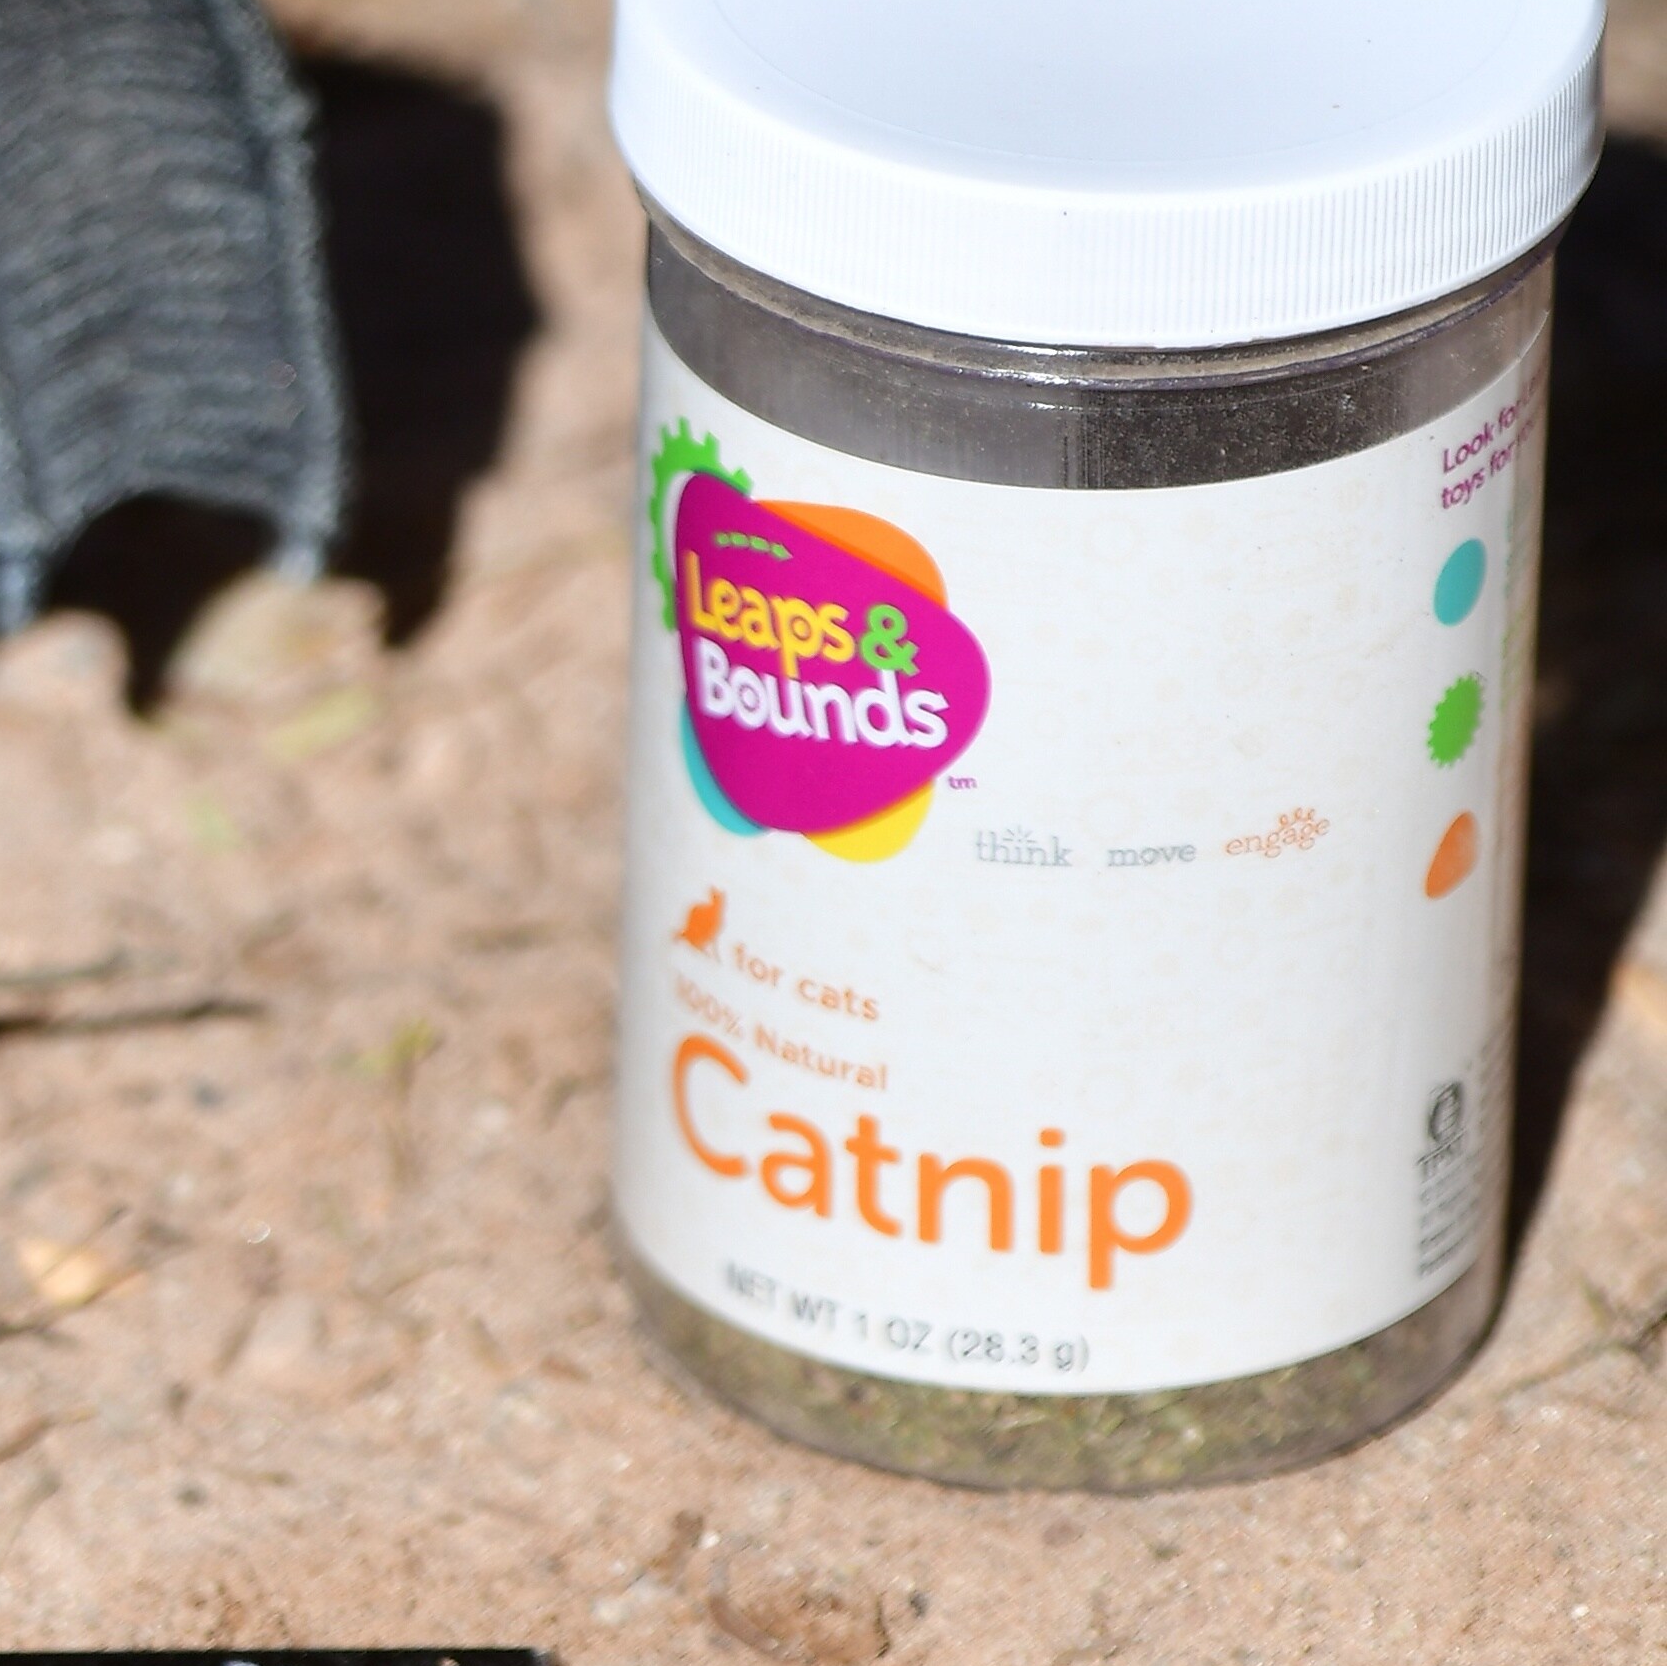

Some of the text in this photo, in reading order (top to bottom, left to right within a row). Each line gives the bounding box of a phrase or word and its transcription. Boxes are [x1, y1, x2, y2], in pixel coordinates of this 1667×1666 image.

[1443, 423, 1494, 473] Look
[1441, 468, 1485, 510] toys
[685, 550, 920, 679] Leaps &
[696, 635, 950, 748] Bounds
[975, 807, 1330, 867] think move engage
[732, 943, 880, 1023] for cats
[752, 1024, 889, 1091] Natural
[671, 1032, 1192, 1291] Catnip
[792, 1291, 839, 1330] WT
[887, 1316, 933, 1352] OZ
[1053, 1334, 1090, 1374] g)
